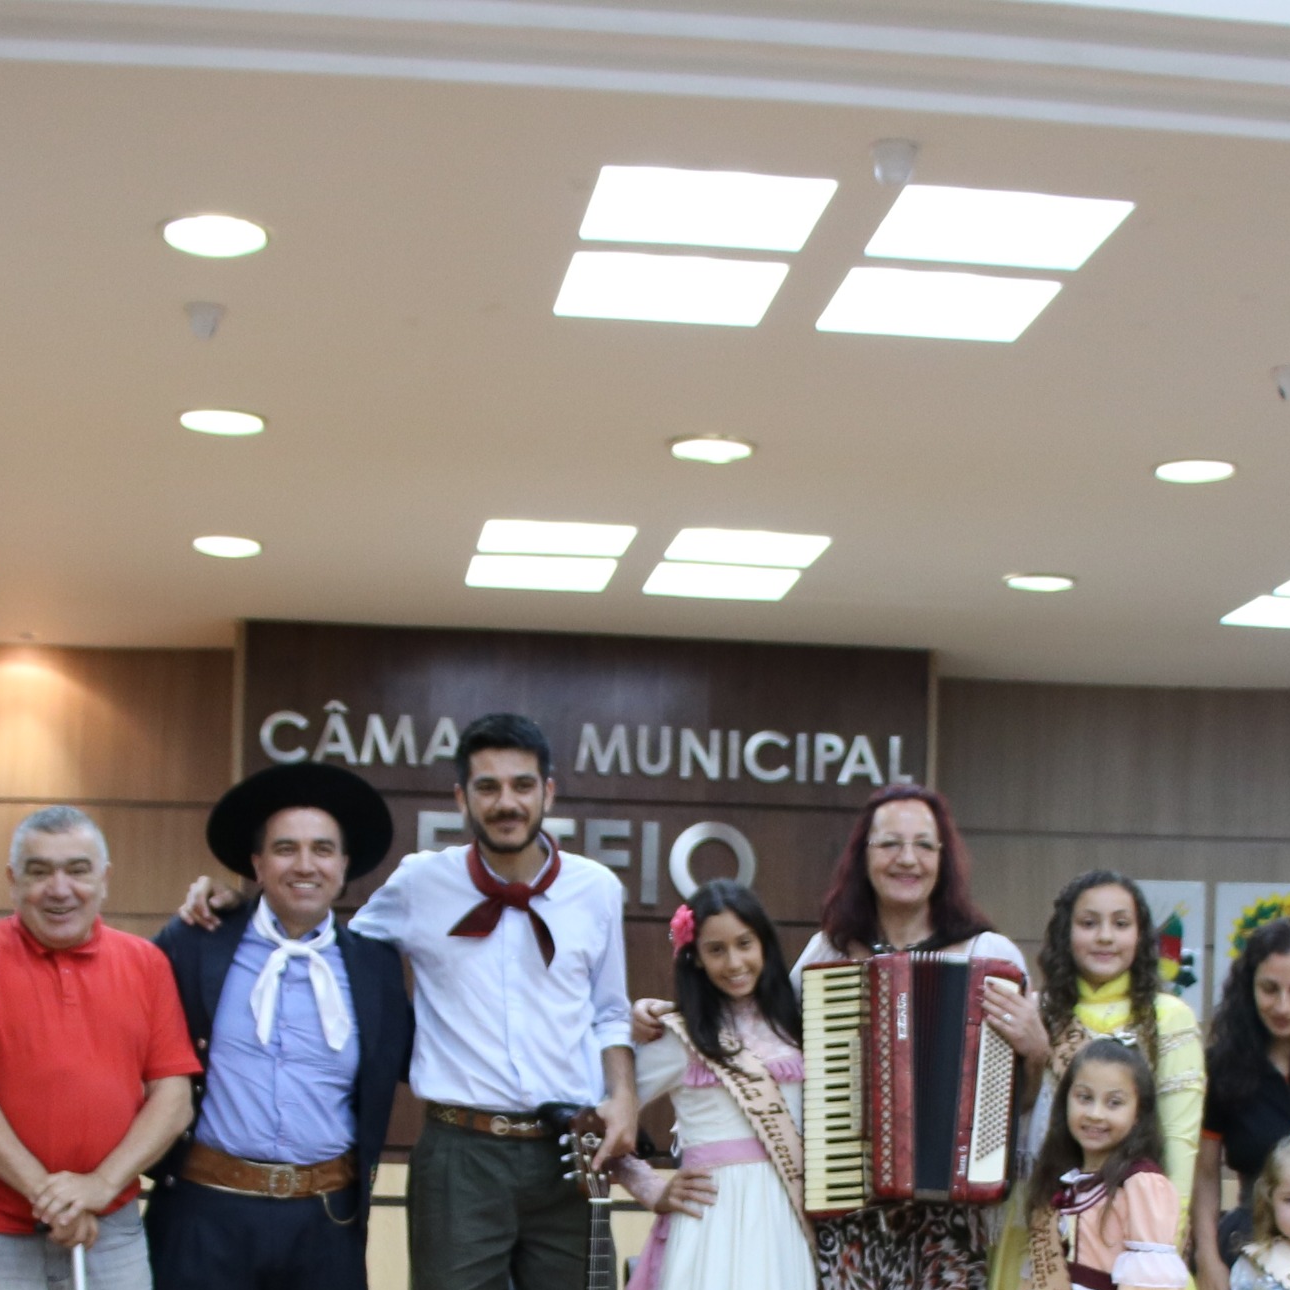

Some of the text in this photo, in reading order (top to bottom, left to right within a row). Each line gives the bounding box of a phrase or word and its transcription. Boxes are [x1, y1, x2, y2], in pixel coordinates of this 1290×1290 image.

[260, 700, 914, 786] CÂMA MUNICIPAL
[417, 811, 756, 905] EEIO
